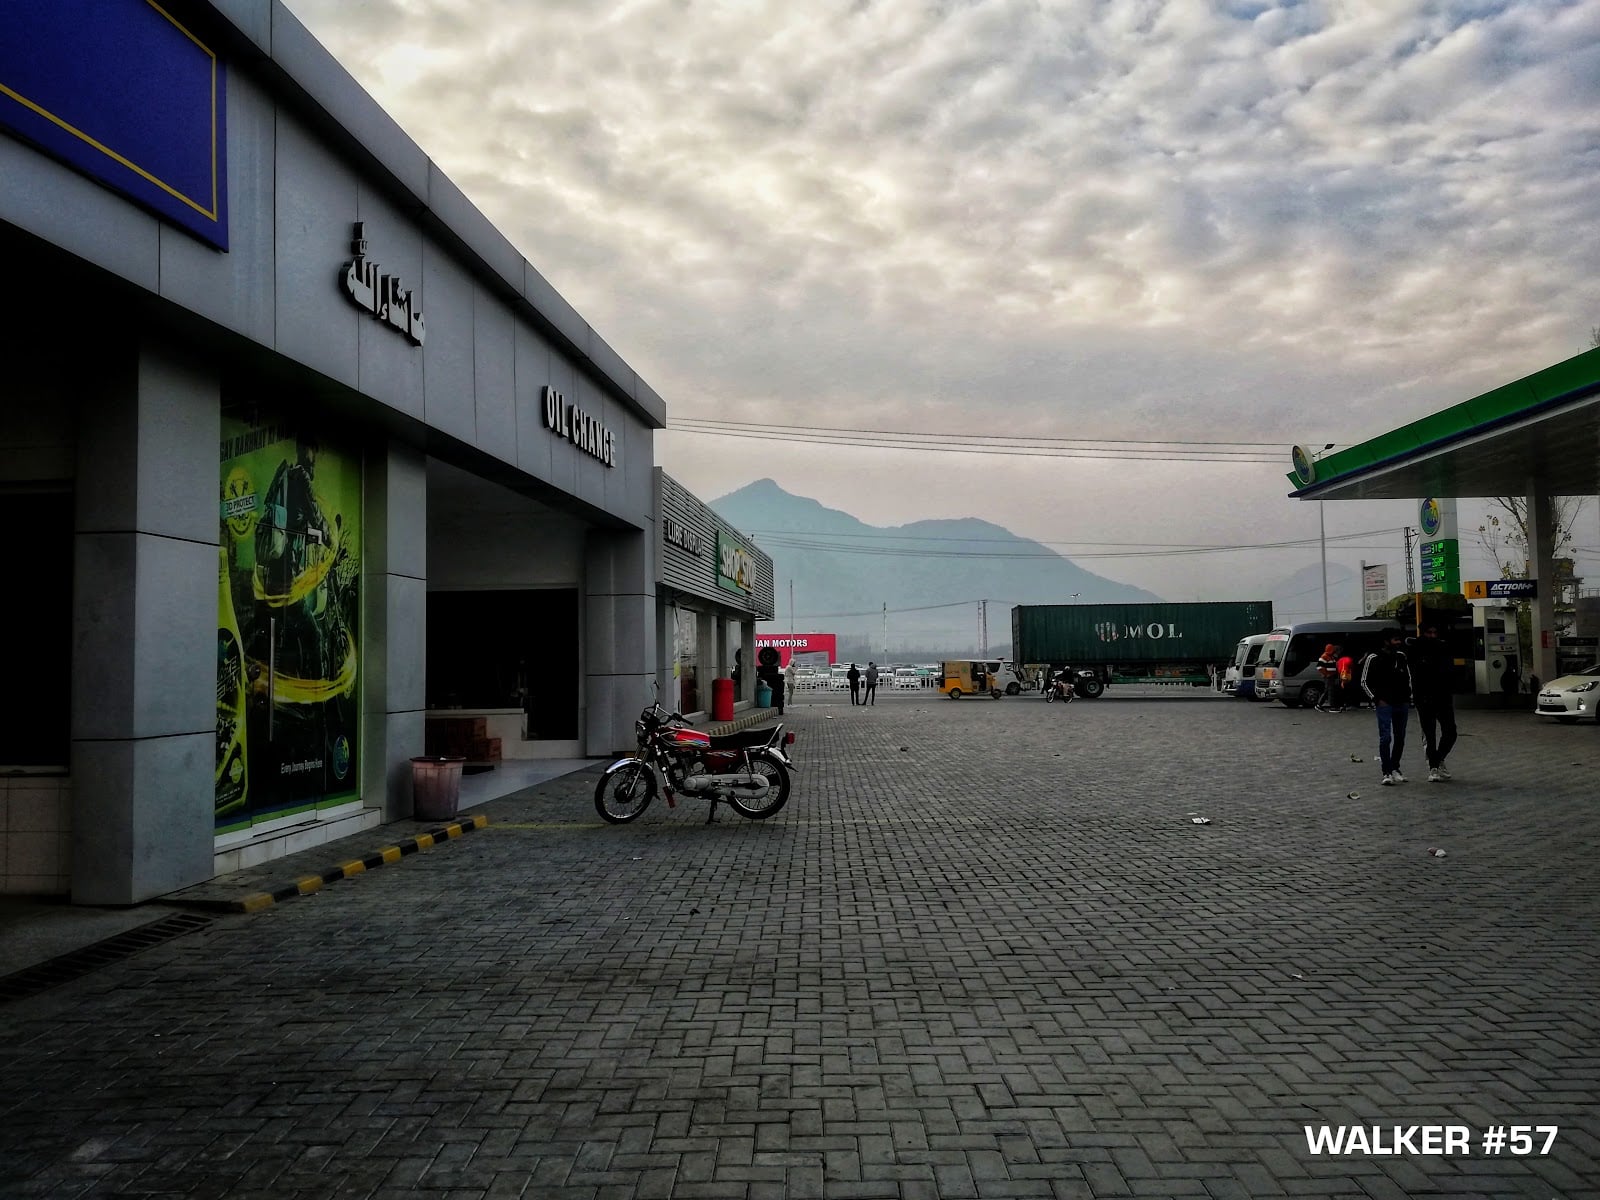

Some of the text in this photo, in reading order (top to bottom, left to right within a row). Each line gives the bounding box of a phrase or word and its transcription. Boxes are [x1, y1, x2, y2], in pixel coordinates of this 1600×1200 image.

[543, 385, 616, 469] OIL CHANGE
[233, 495, 255, 510] PROTECT
[665, 519, 683, 547] LUBE
[721, 543, 740, 584] SHOP
[1474, 584, 1482, 596] 4
[1123, 622, 1183, 640] MOL
[772, 639, 808, 648] MOTORS
